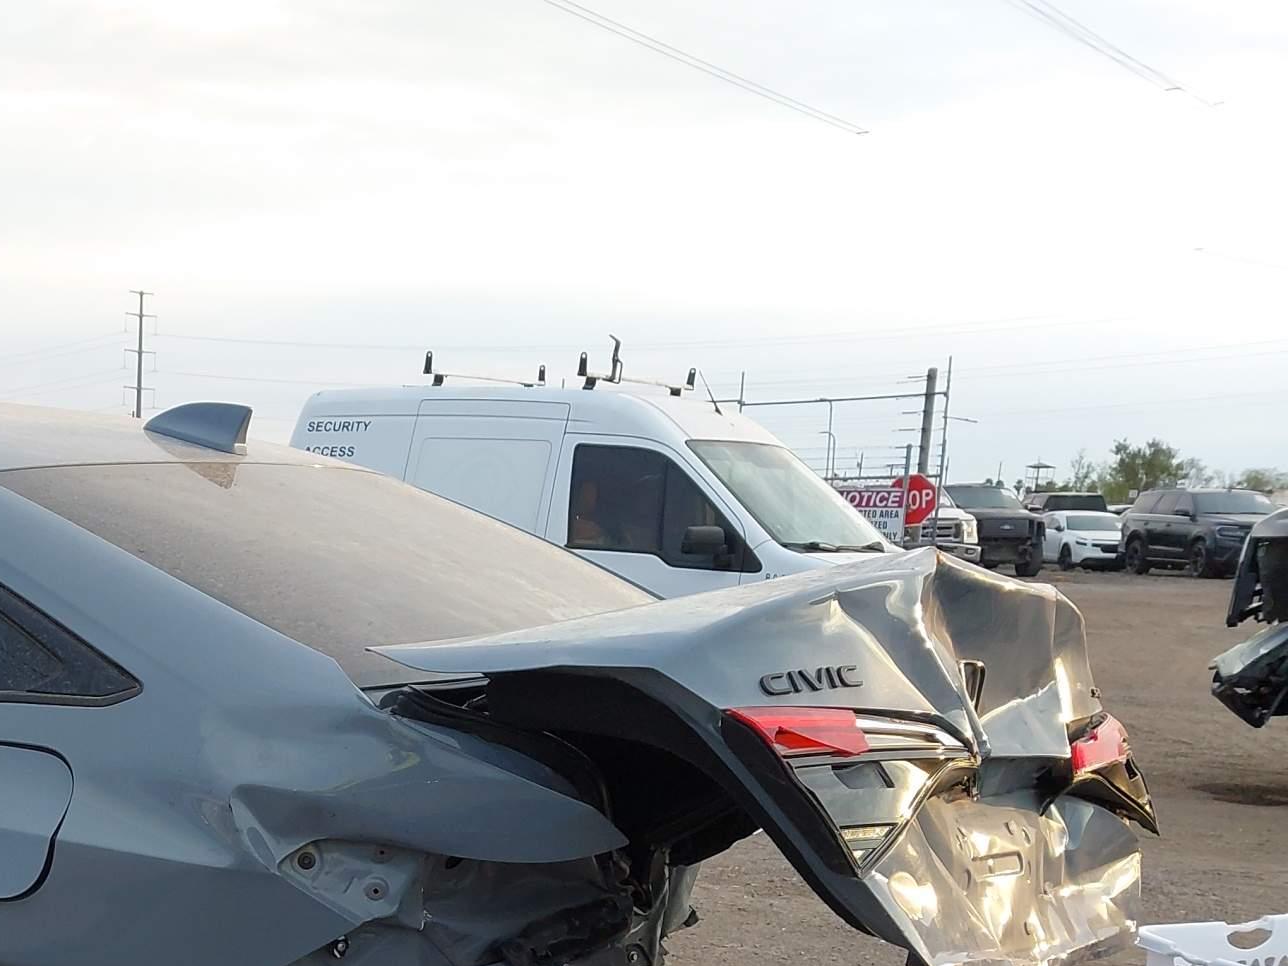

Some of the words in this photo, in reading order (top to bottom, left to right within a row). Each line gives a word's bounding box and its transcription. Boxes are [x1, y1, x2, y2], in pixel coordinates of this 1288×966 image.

[307, 420, 372, 432] SECURITY
[908, 489, 934, 510] OP
[878, 509, 899, 519] AREA
[759, 664, 864, 697] CIVIC
